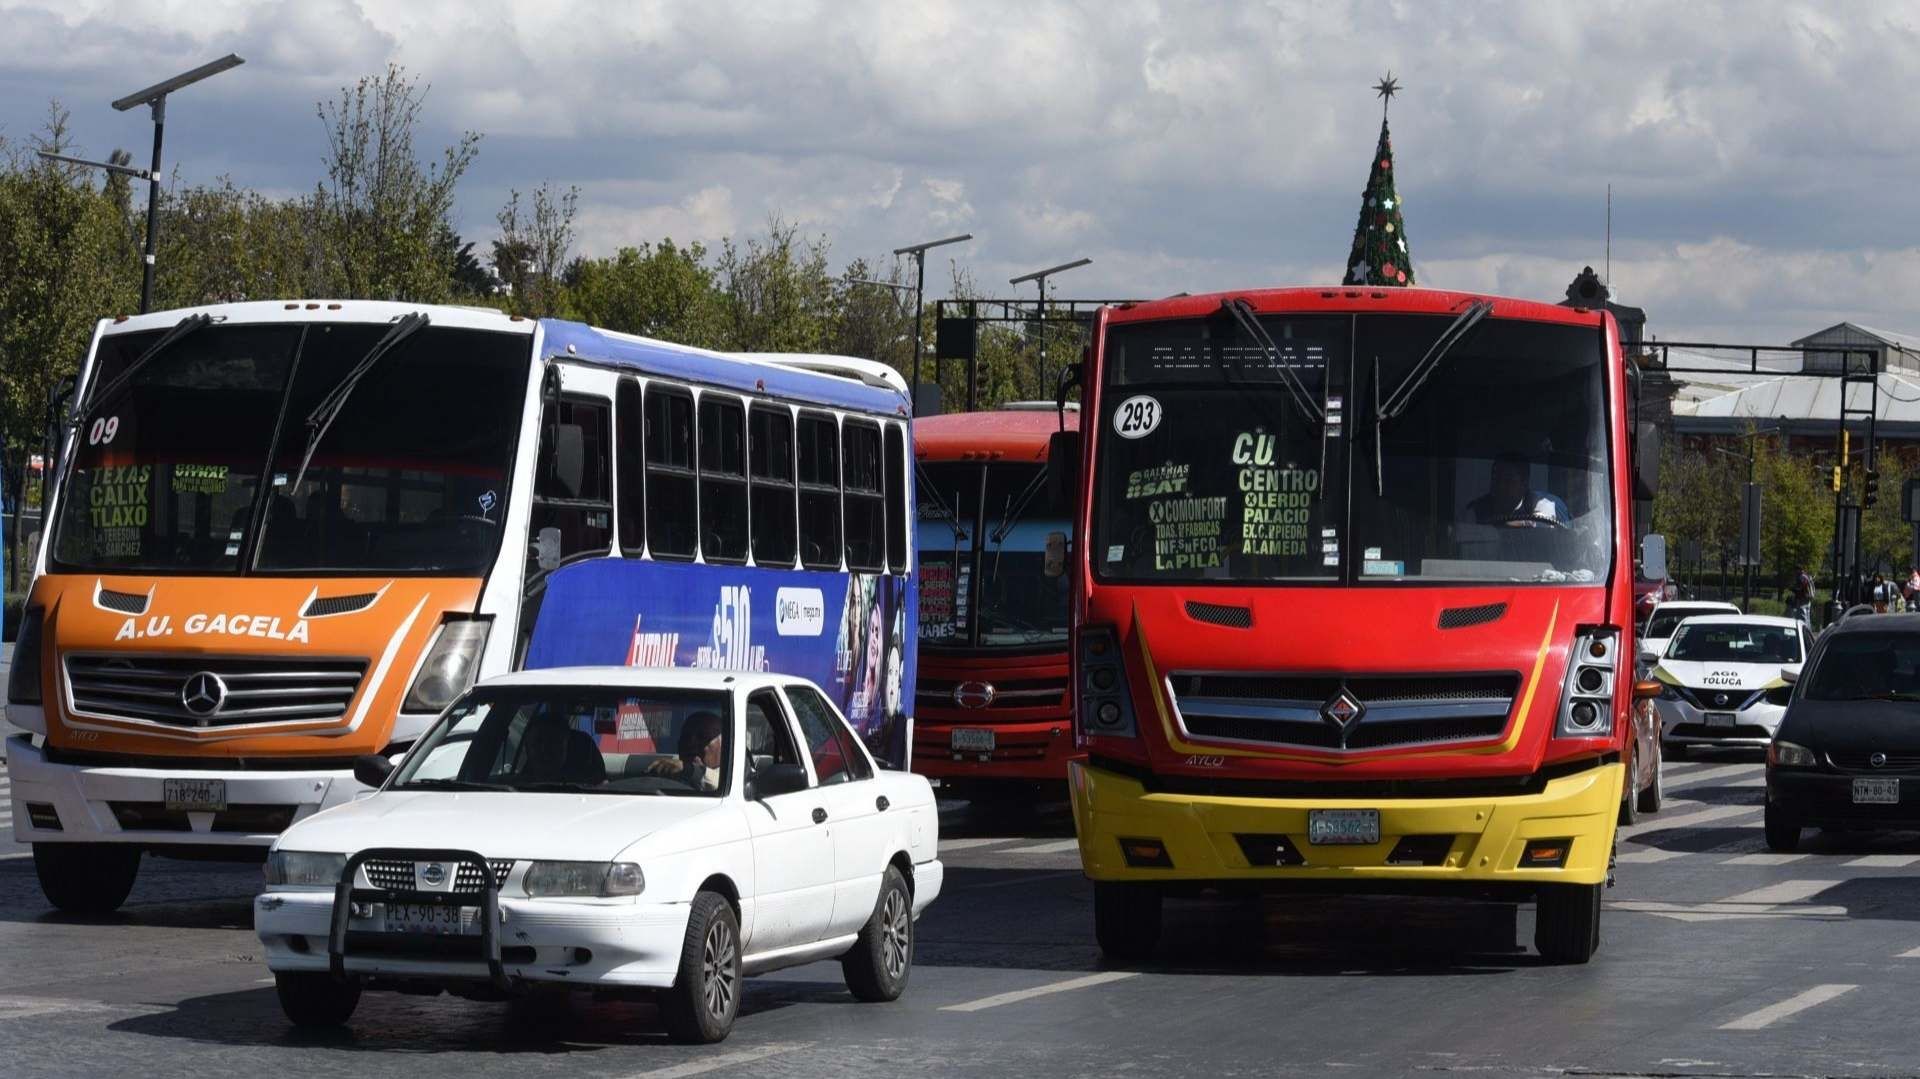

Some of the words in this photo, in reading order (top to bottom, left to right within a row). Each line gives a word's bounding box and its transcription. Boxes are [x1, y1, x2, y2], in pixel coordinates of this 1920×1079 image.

[1121, 401, 1154, 432] 293
[89, 416, 119, 445] 09
[1232, 432, 1276, 466] C.U.
[92, 465, 151, 485] TEXAS
[1239, 469, 1318, 491] CENTRO
[90, 484, 148, 506] CALIX
[1142, 478, 1187, 496] SAT
[1165, 497, 1227, 522] COMONFORT
[1258, 492, 1311, 507] LERDO
[90, 506, 147, 527] TLAXO
[1244, 508, 1310, 523] PALACIO
[1242, 540, 1308, 555] ALAMEDA
[1175, 553, 1220, 569] PILA
[114, 615, 173, 641] A.U.
[184, 613, 309, 644] GACELA
[1703, 676, 1742, 686] TOLUCA
